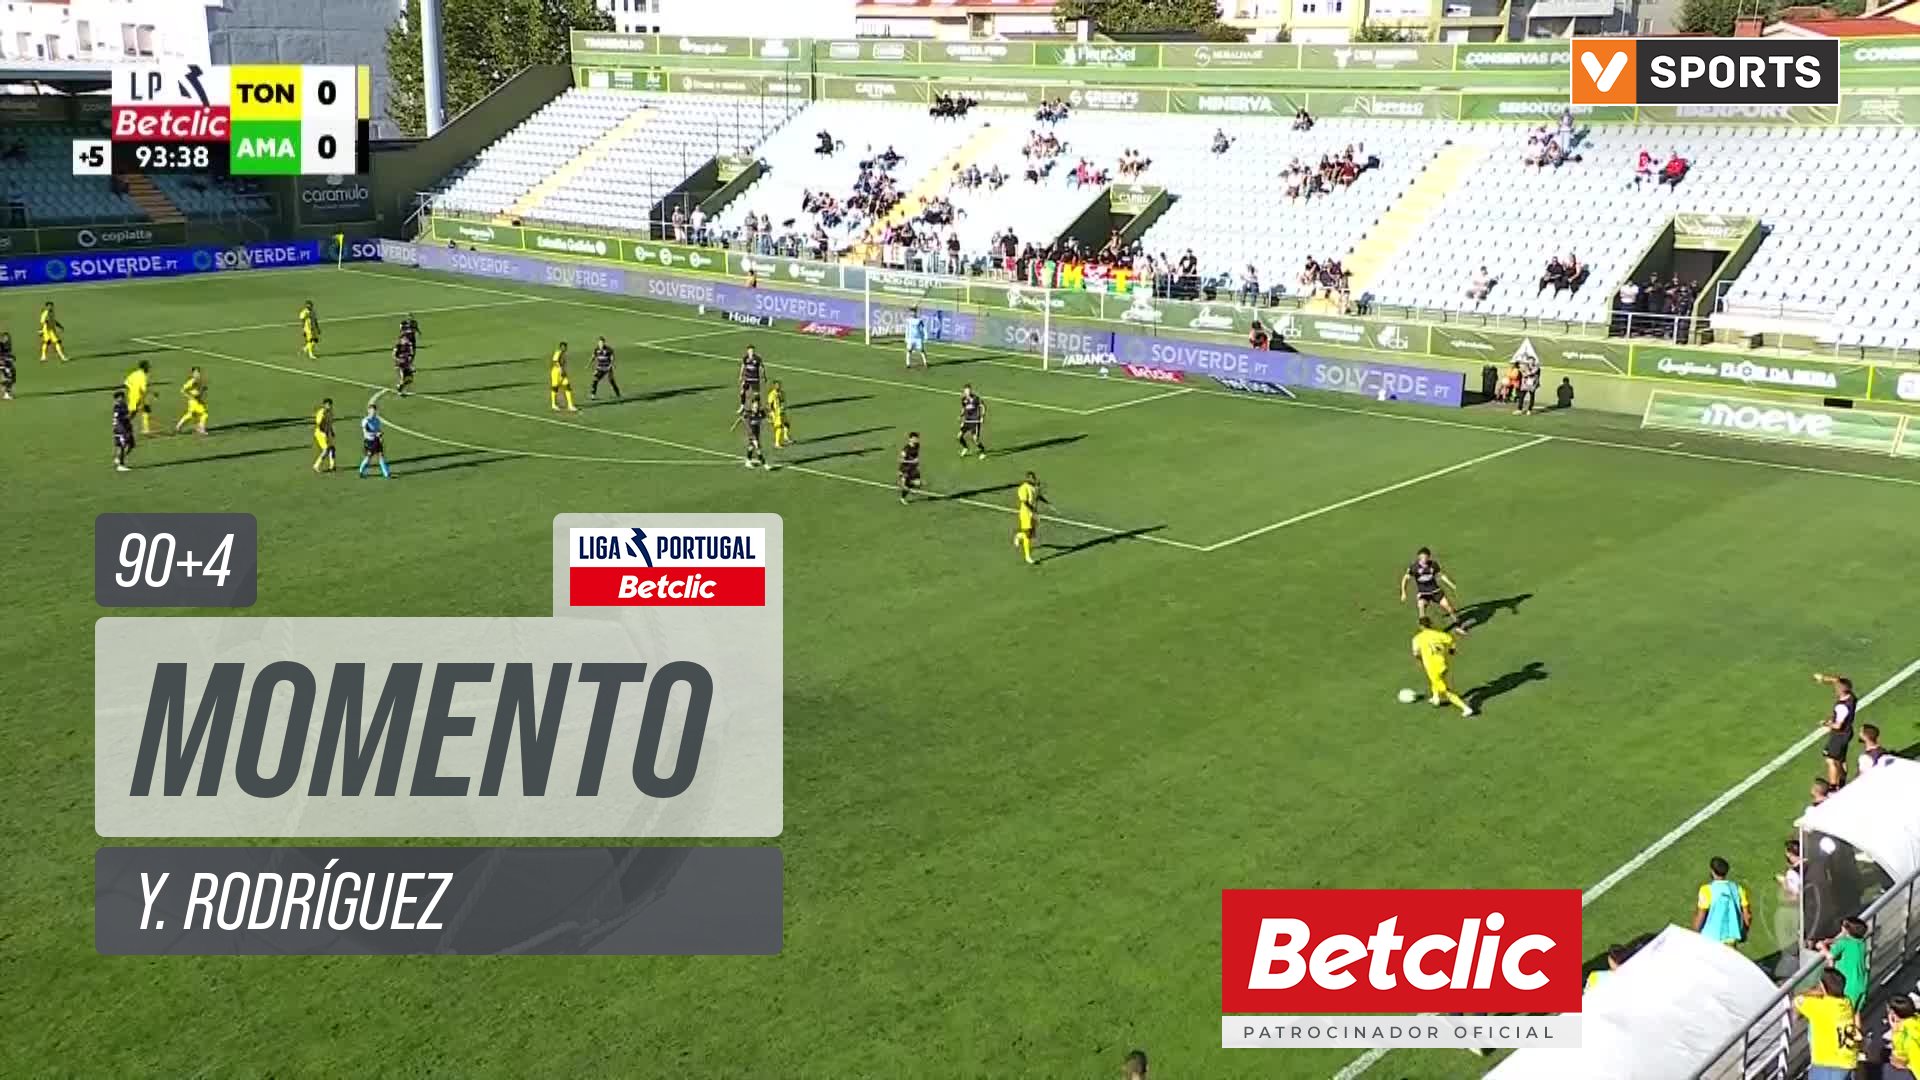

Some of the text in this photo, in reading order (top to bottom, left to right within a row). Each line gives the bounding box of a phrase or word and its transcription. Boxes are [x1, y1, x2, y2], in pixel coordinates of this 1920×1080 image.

[1198, 95, 1272, 111] MINERVA
[302, 184, 369, 203] caramulo
[70, 255, 179, 277] SOLVERDE.PT
[1700, 402, 1832, 438] moeve
